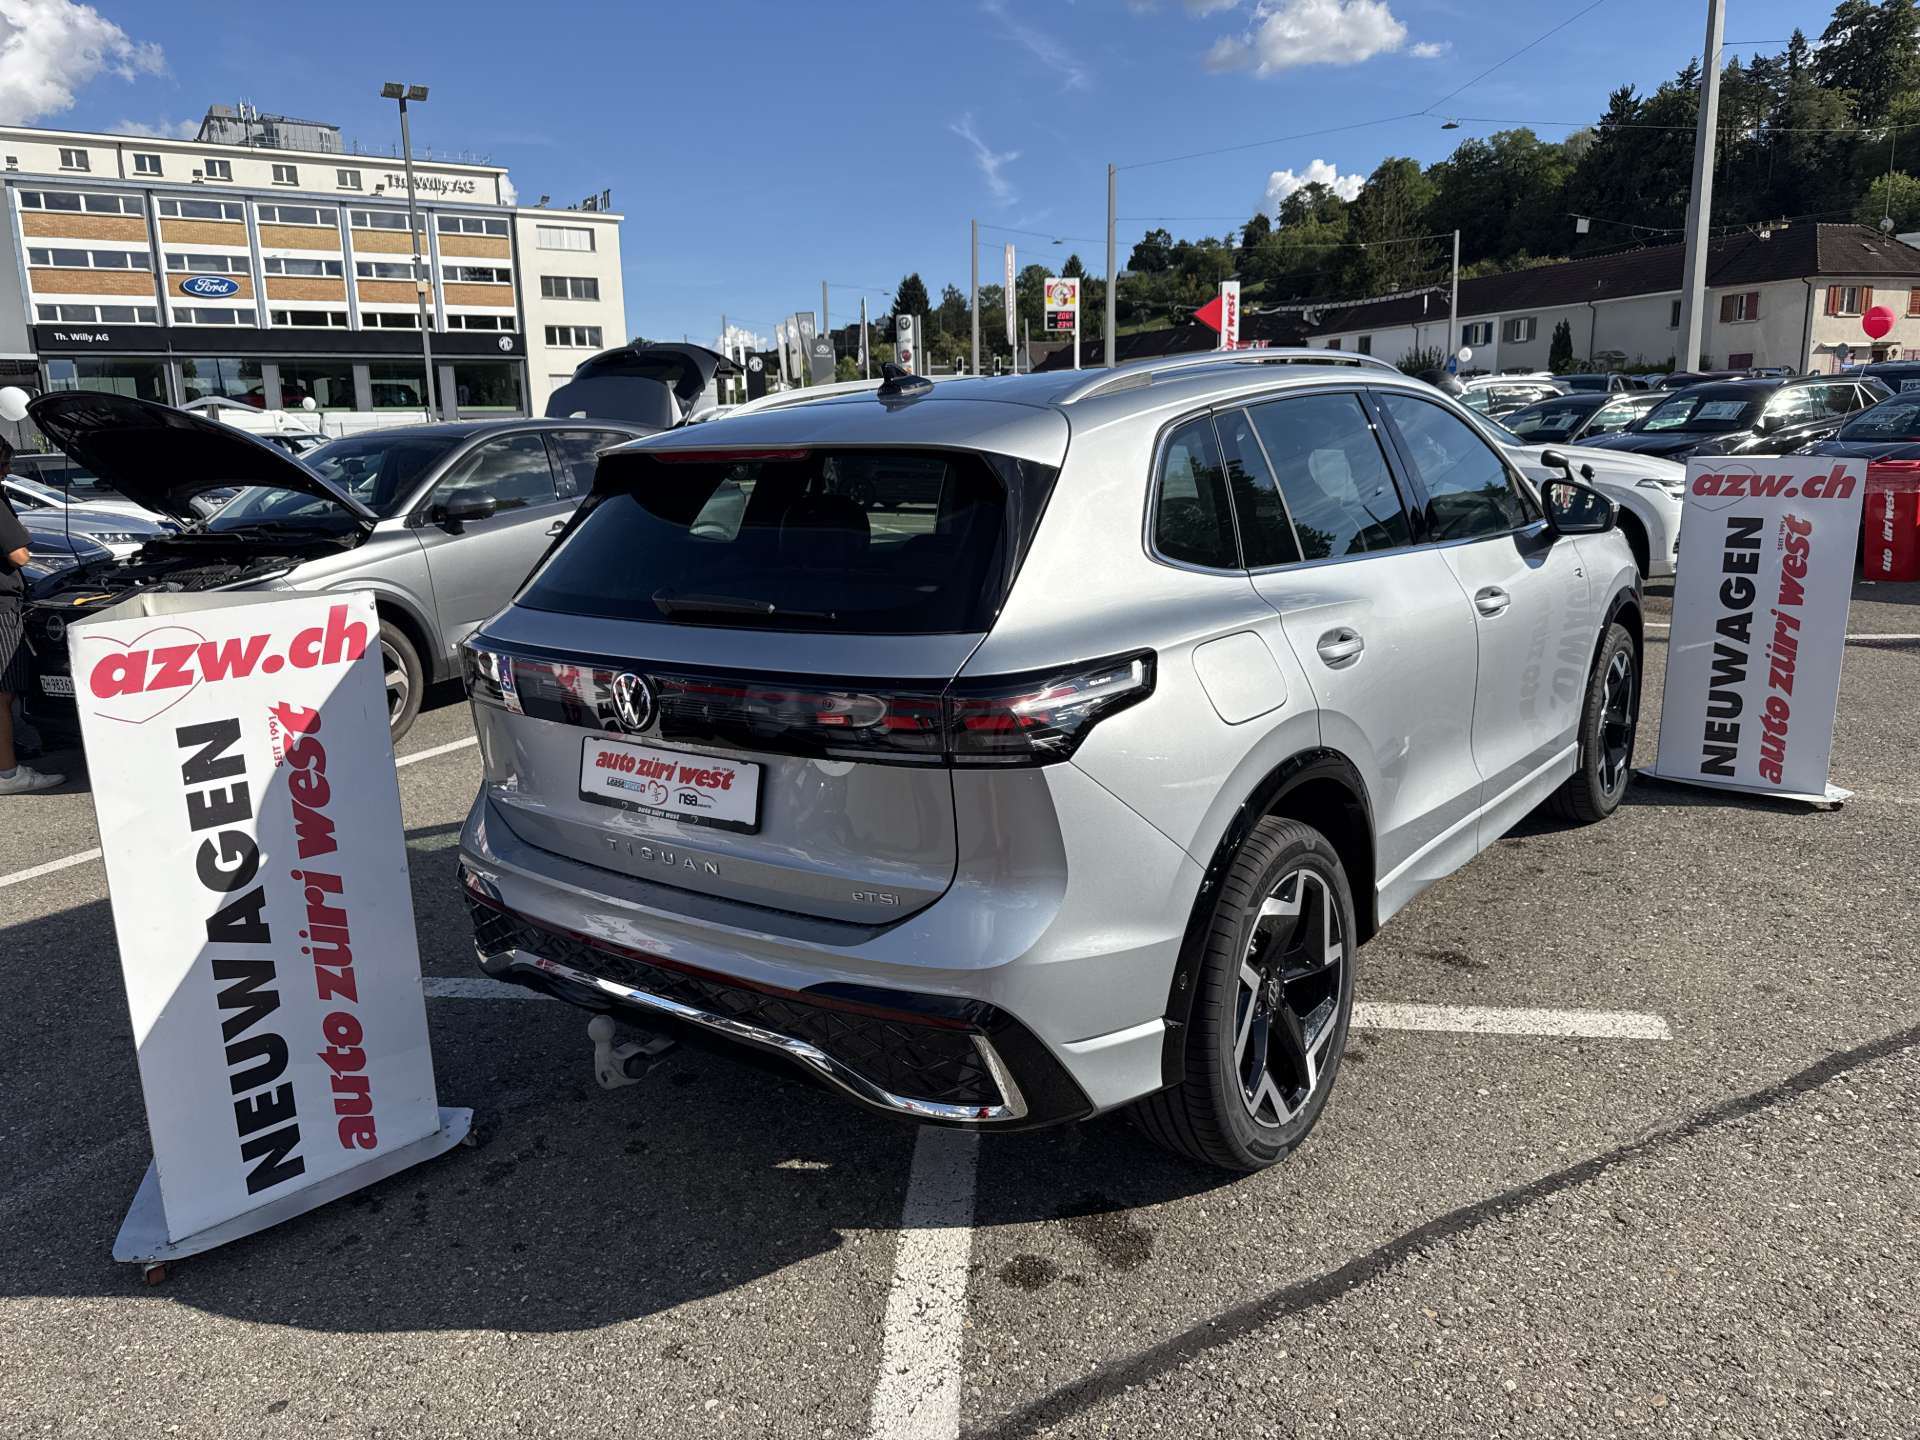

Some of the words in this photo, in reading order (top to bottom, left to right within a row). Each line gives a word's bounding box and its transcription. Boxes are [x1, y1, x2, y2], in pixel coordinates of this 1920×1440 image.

[194, 278, 229, 294] Ford
[54, 332, 69, 342] Th.
[70, 332, 94, 343] Willy
[95, 333, 110, 342] AG
[748, 356, 763, 372] MG
[1692, 464, 1857, 499] azw.ch
[1778, 513, 1813, 606] west
[89, 604, 368, 700] azw.ch
[1700, 516, 1765, 777] NEUWAGEN
[1763, 609, 1801, 697] züri
[268, 715, 280, 742] 1991
[1759, 696, 1790, 785] auto
[272, 745, 284, 768] SEIT
[595, 751, 636, 773] auto
[635, 757, 678, 781] züri
[679, 766, 736, 790] west
[268, 700, 338, 861] west
[678, 792, 698, 807] nsa
[606, 838, 721, 875] TIGUAN
[851, 890, 901, 906] eTSI
[175, 717, 306, 1196] NEUWAGEN
[298, 871, 359, 1004] züri
[316, 1010, 377, 1150] auto
